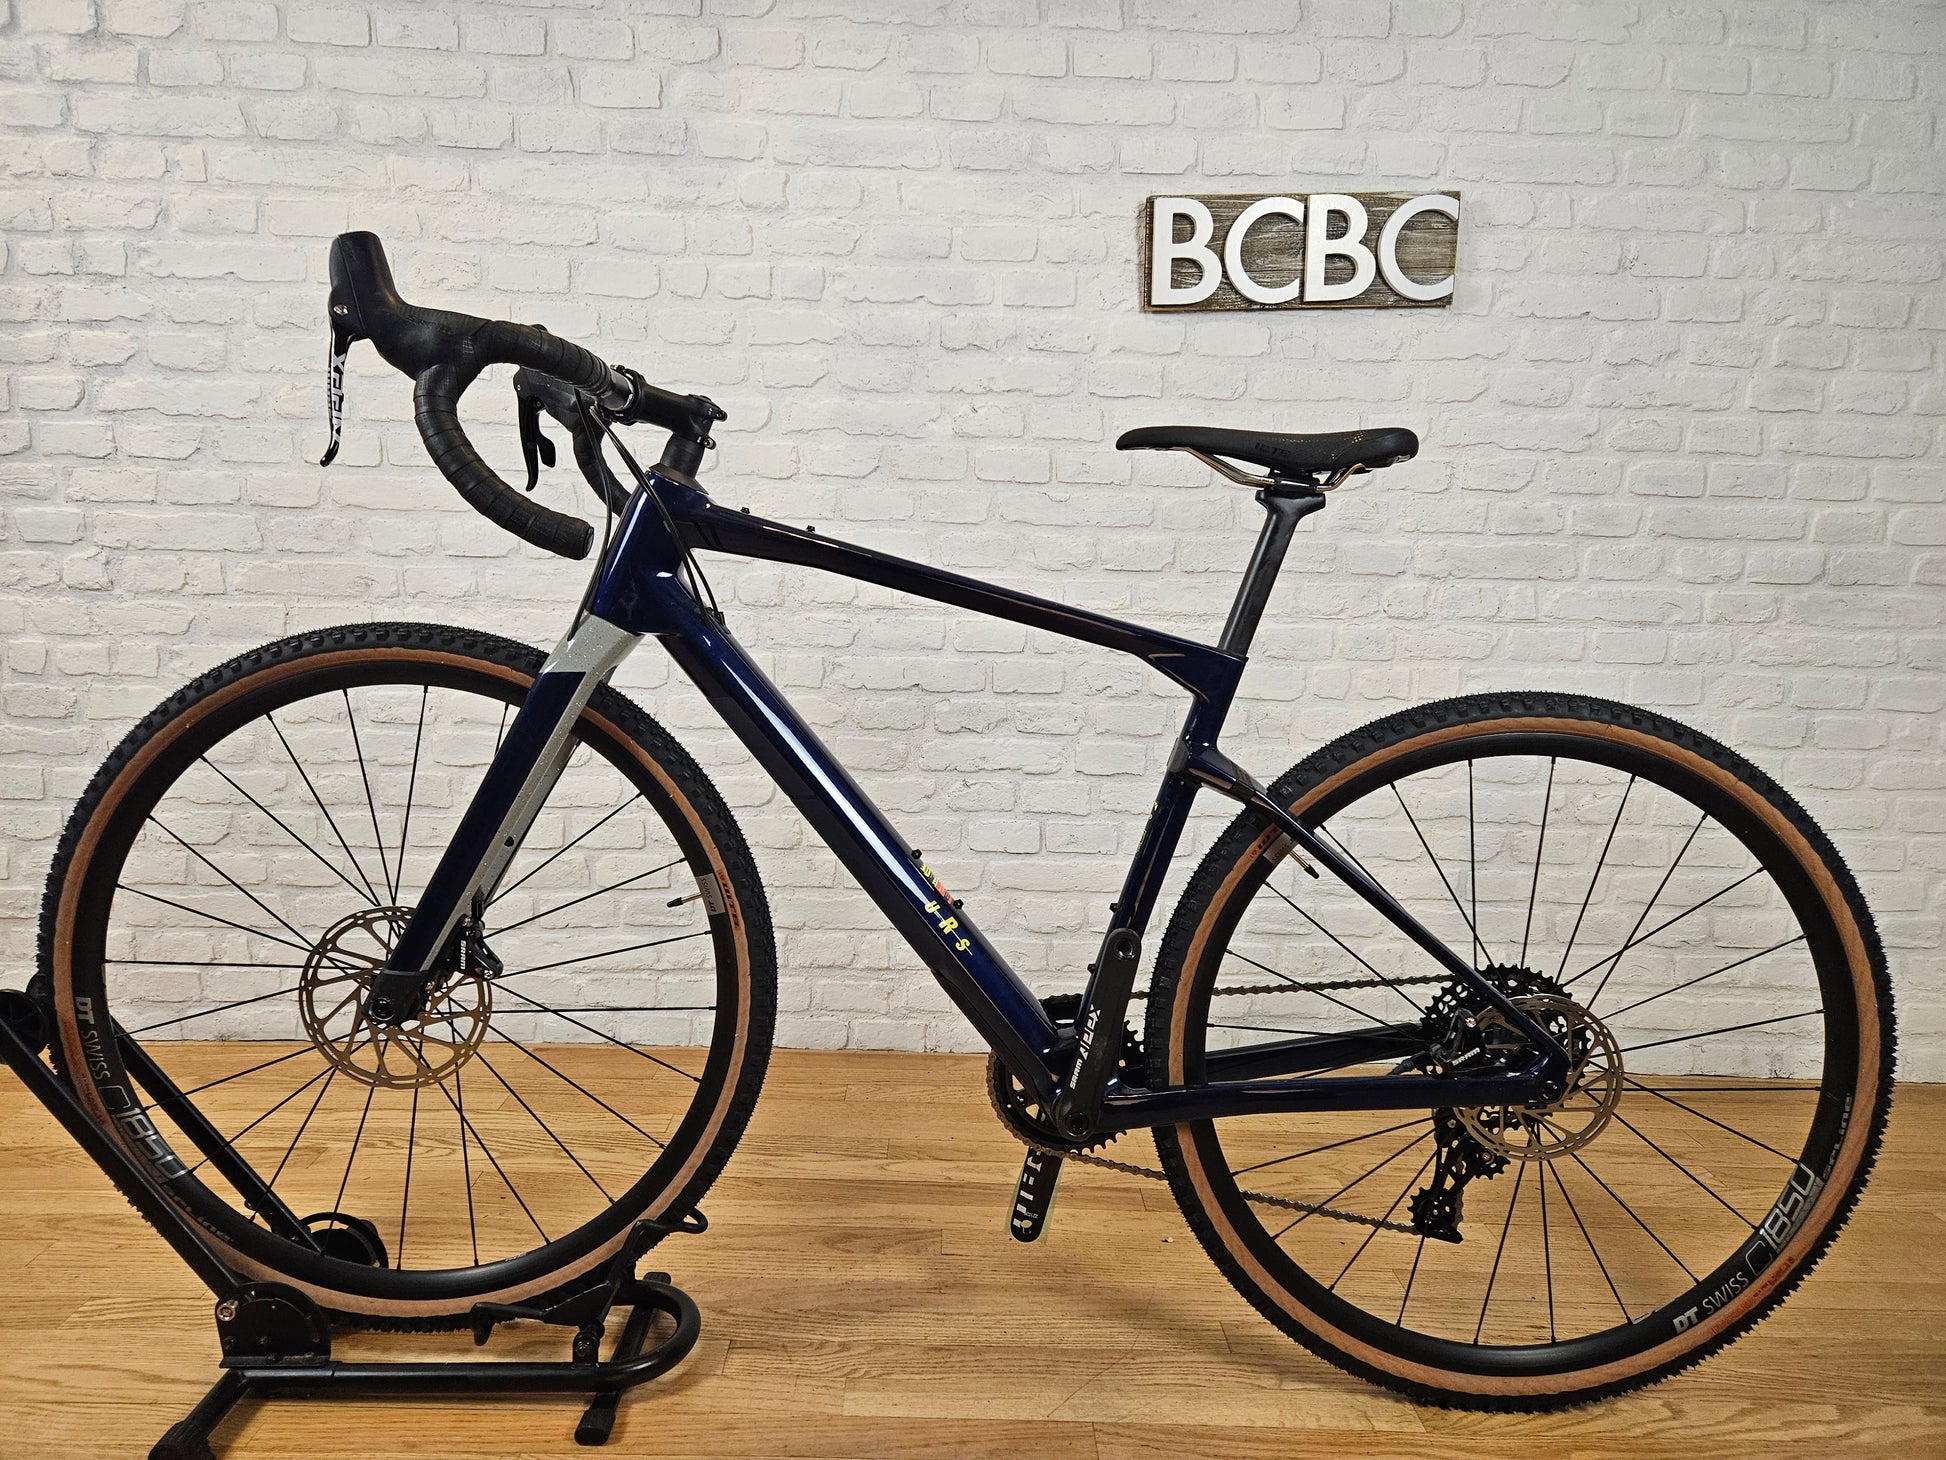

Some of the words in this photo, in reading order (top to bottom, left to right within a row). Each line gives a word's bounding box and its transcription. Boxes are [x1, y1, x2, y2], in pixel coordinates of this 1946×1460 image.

[1151, 194, 1459, 304] BCBC
[75, 996, 95, 1025] DT
[81, 1029, 111, 1081] SWISS
[1069, 1058, 1083, 1090] SRAM
[1451, 1047, 1480, 1066] SRAM
[1672, 1306, 1699, 1335] DT
[1702, 1271, 1750, 1315] SWISS
